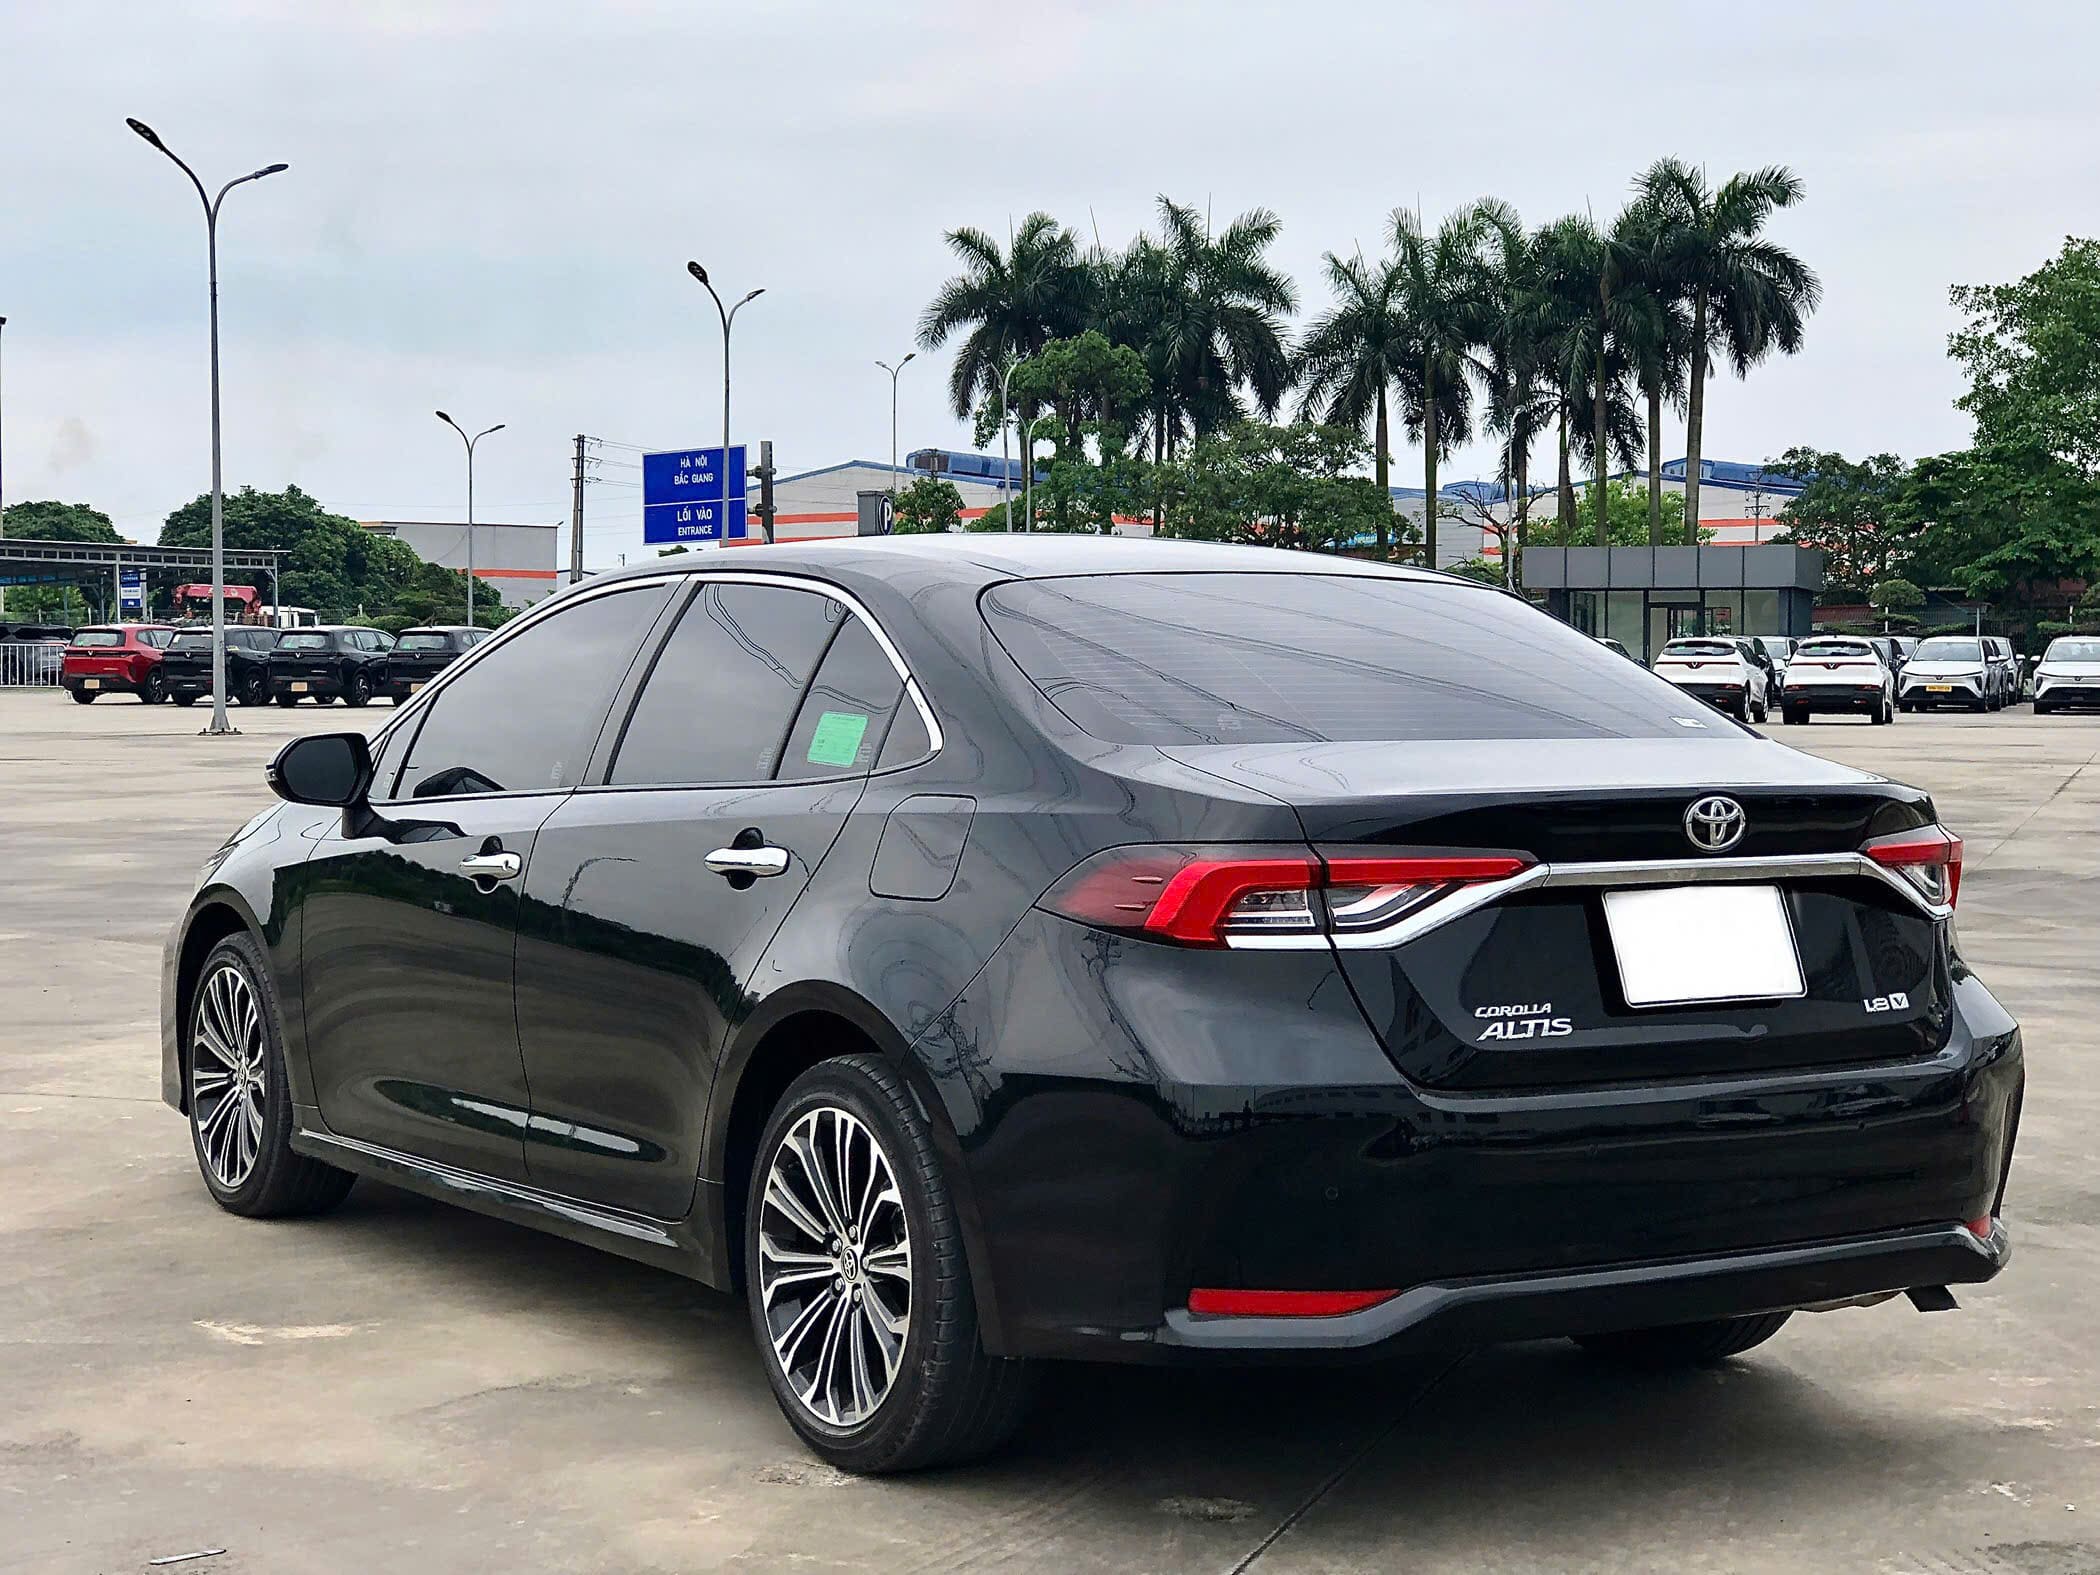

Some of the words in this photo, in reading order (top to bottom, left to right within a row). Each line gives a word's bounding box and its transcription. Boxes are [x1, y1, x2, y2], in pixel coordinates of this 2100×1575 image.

[680, 455, 691, 468] HÀ
[695, 454, 708, 468] NỘI
[674, 470, 689, 485] BẮC
[691, 472, 714, 483] GIANG
[677, 505, 691, 521] LỐI
[696, 506, 713, 520] VÀO
[884, 502, 893, 529] P
[678, 525, 713, 536] ENTRANCE
[1474, 1002, 1552, 1018] COROLLA
[1476, 1018, 1573, 1042] ALTIS
